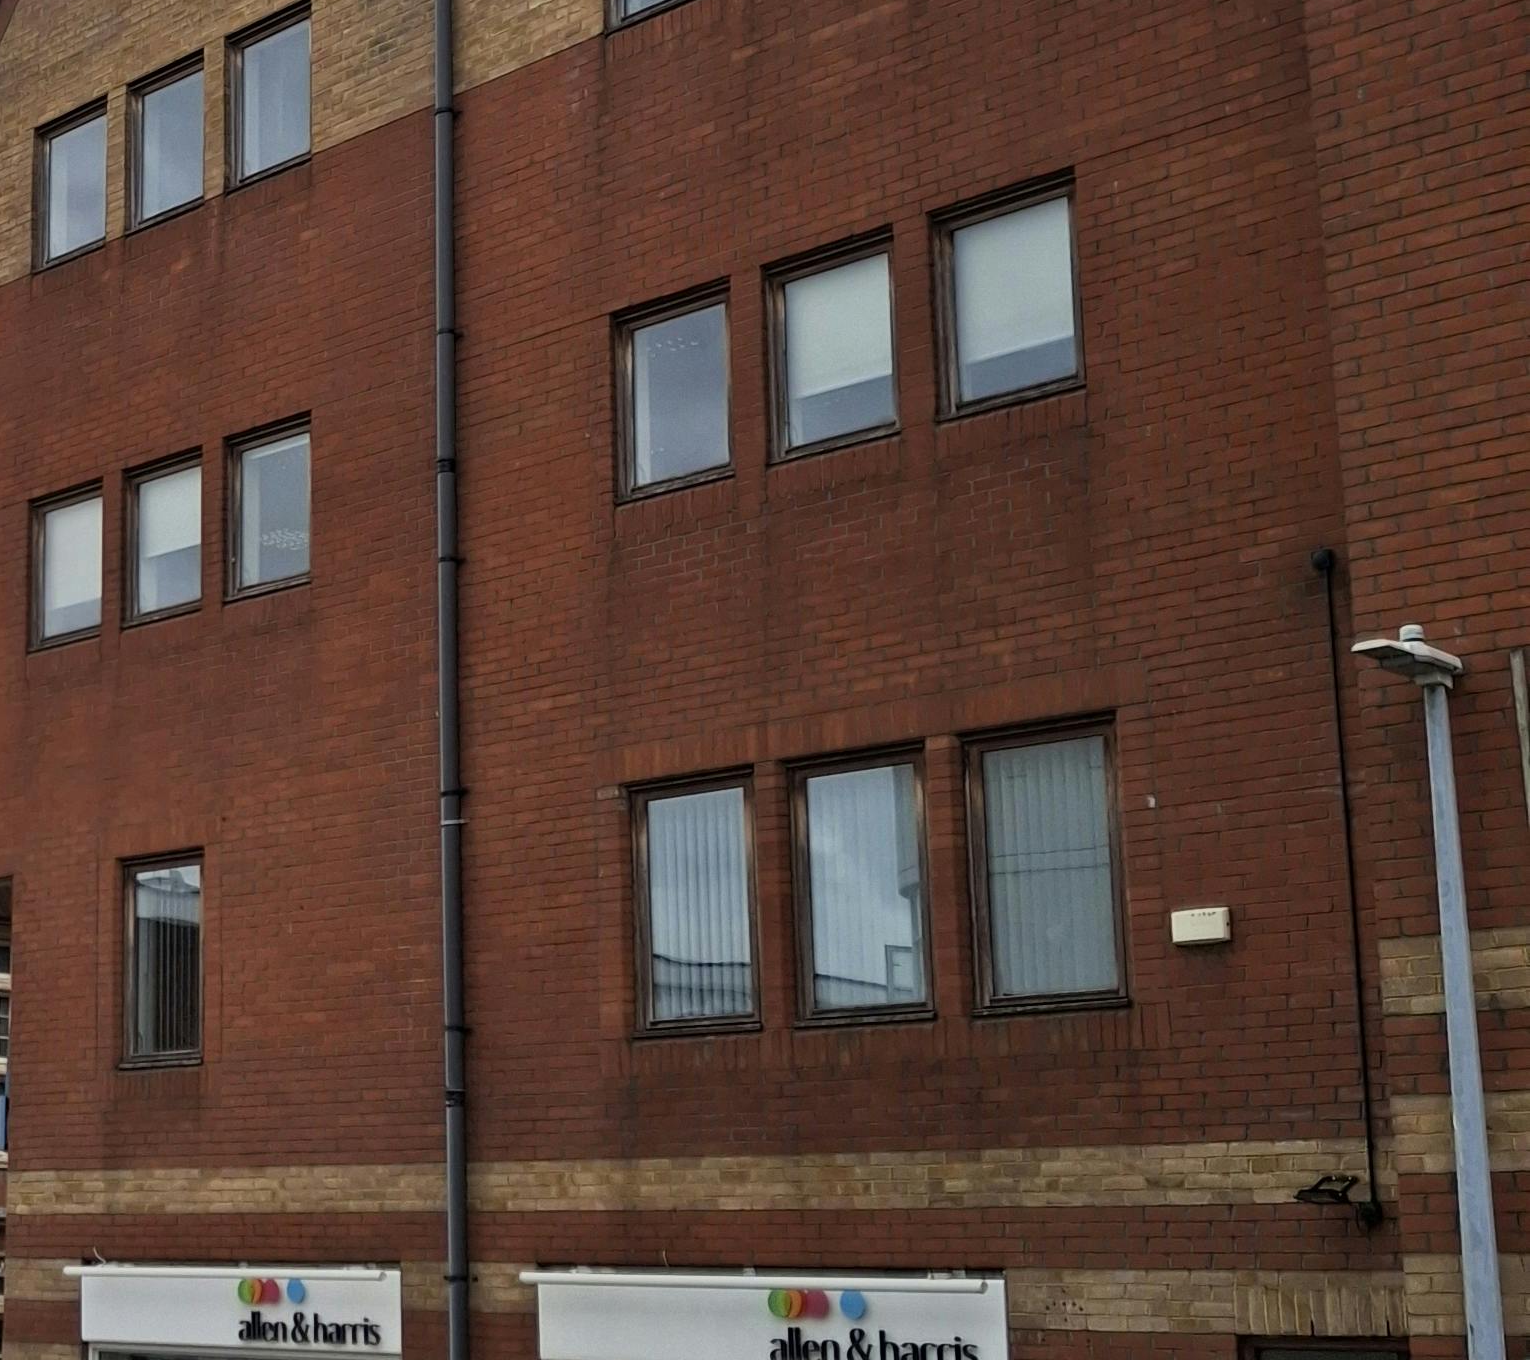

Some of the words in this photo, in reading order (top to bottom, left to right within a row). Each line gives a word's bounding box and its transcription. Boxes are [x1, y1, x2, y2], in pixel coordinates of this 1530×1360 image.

[238, 1311, 288, 1343] allen
[291, 1311, 310, 1344] &
[313, 1312, 382, 1346] harris
